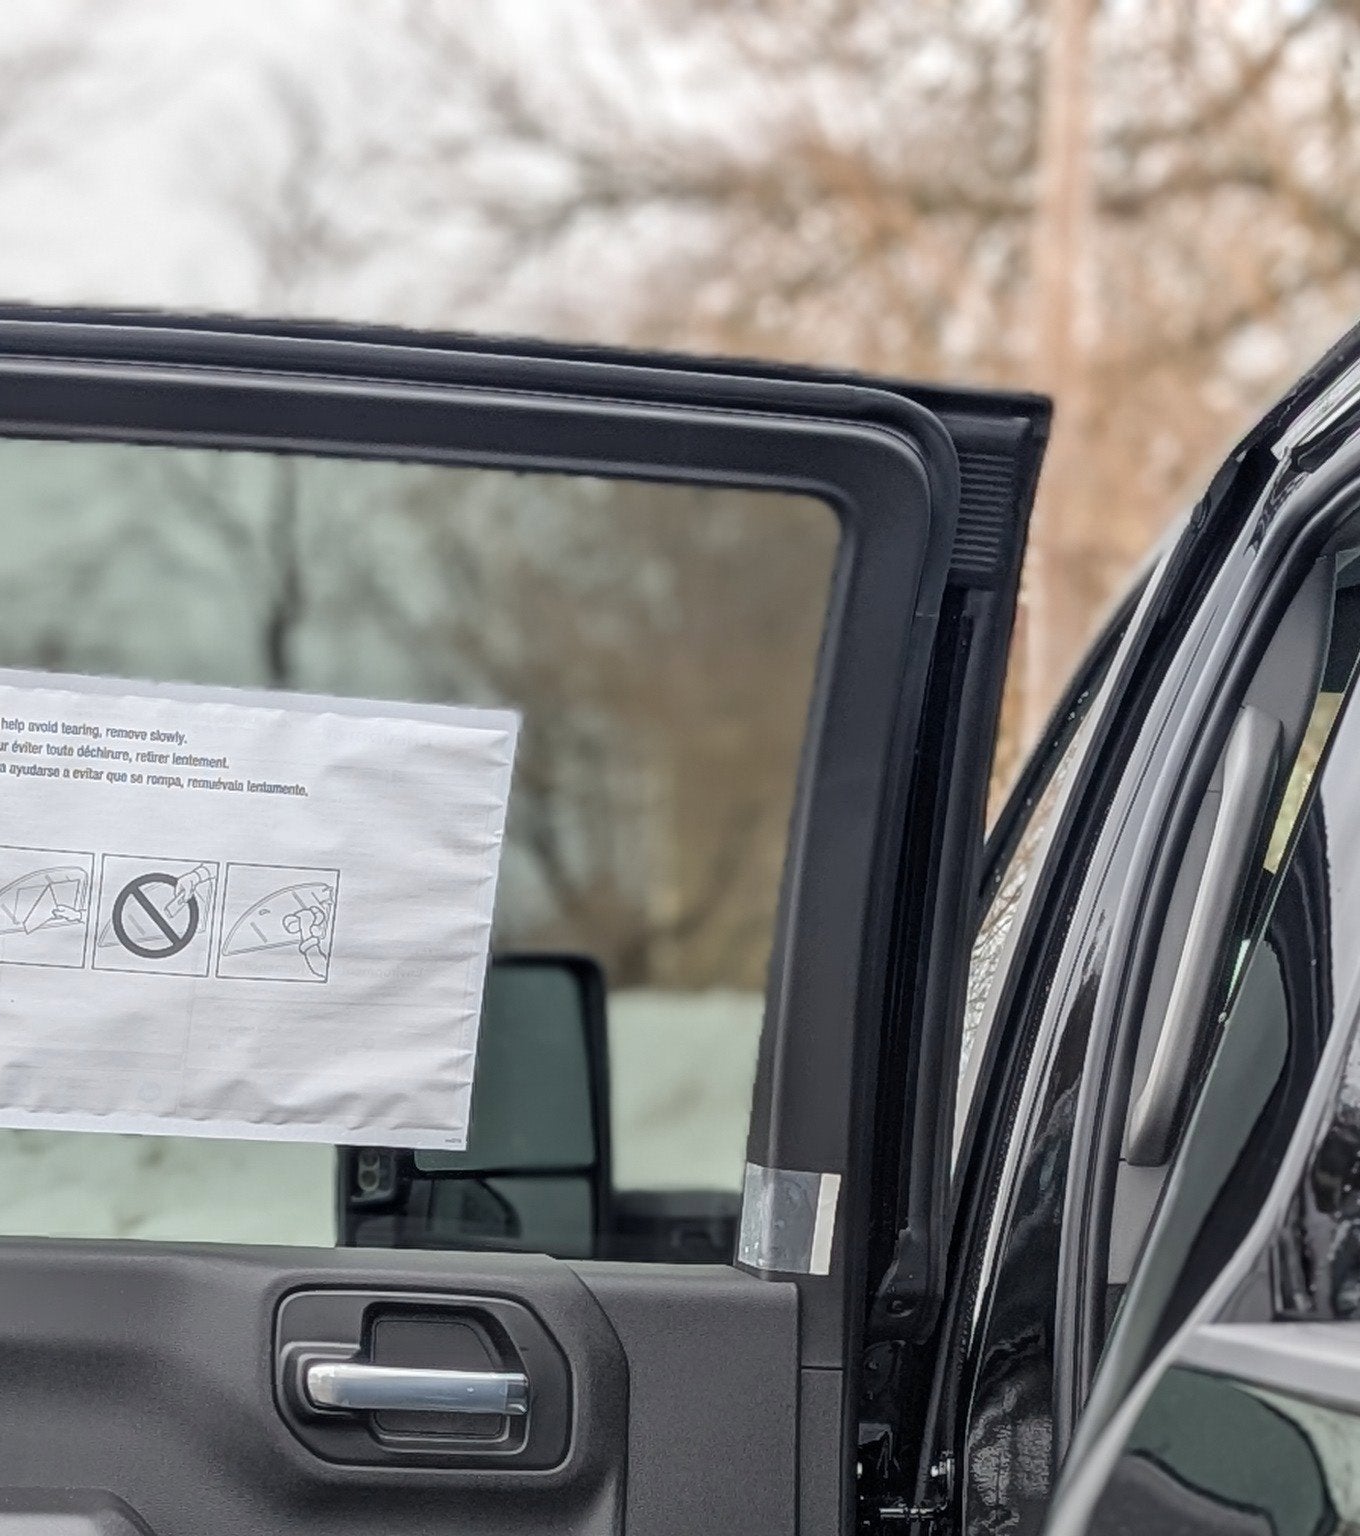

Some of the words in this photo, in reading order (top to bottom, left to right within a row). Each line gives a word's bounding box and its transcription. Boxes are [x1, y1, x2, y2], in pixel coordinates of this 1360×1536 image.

[1, 717, 25, 733] help
[28, 720, 58, 734] avoid
[61, 722, 103, 739] tearing,
[105, 727, 147, 741] remove
[149, 729, 188, 746] slowly.
[11, 740, 43, 755] éviter
[46, 743, 74, 757] toute
[77, 744, 133, 763] déchirure,
[135, 751, 170, 764] retirer
[172, 752, 230, 770] lentement.
[9, 762, 60, 778] ayudarse
[63, 769, 71, 779] a
[72, 767, 104, 781] evitar
[106, 771, 128, 783] que
[130, 773, 144, 784] se
[146, 774, 184, 789] rompa,
[246, 780, 309, 798] lentamente.
